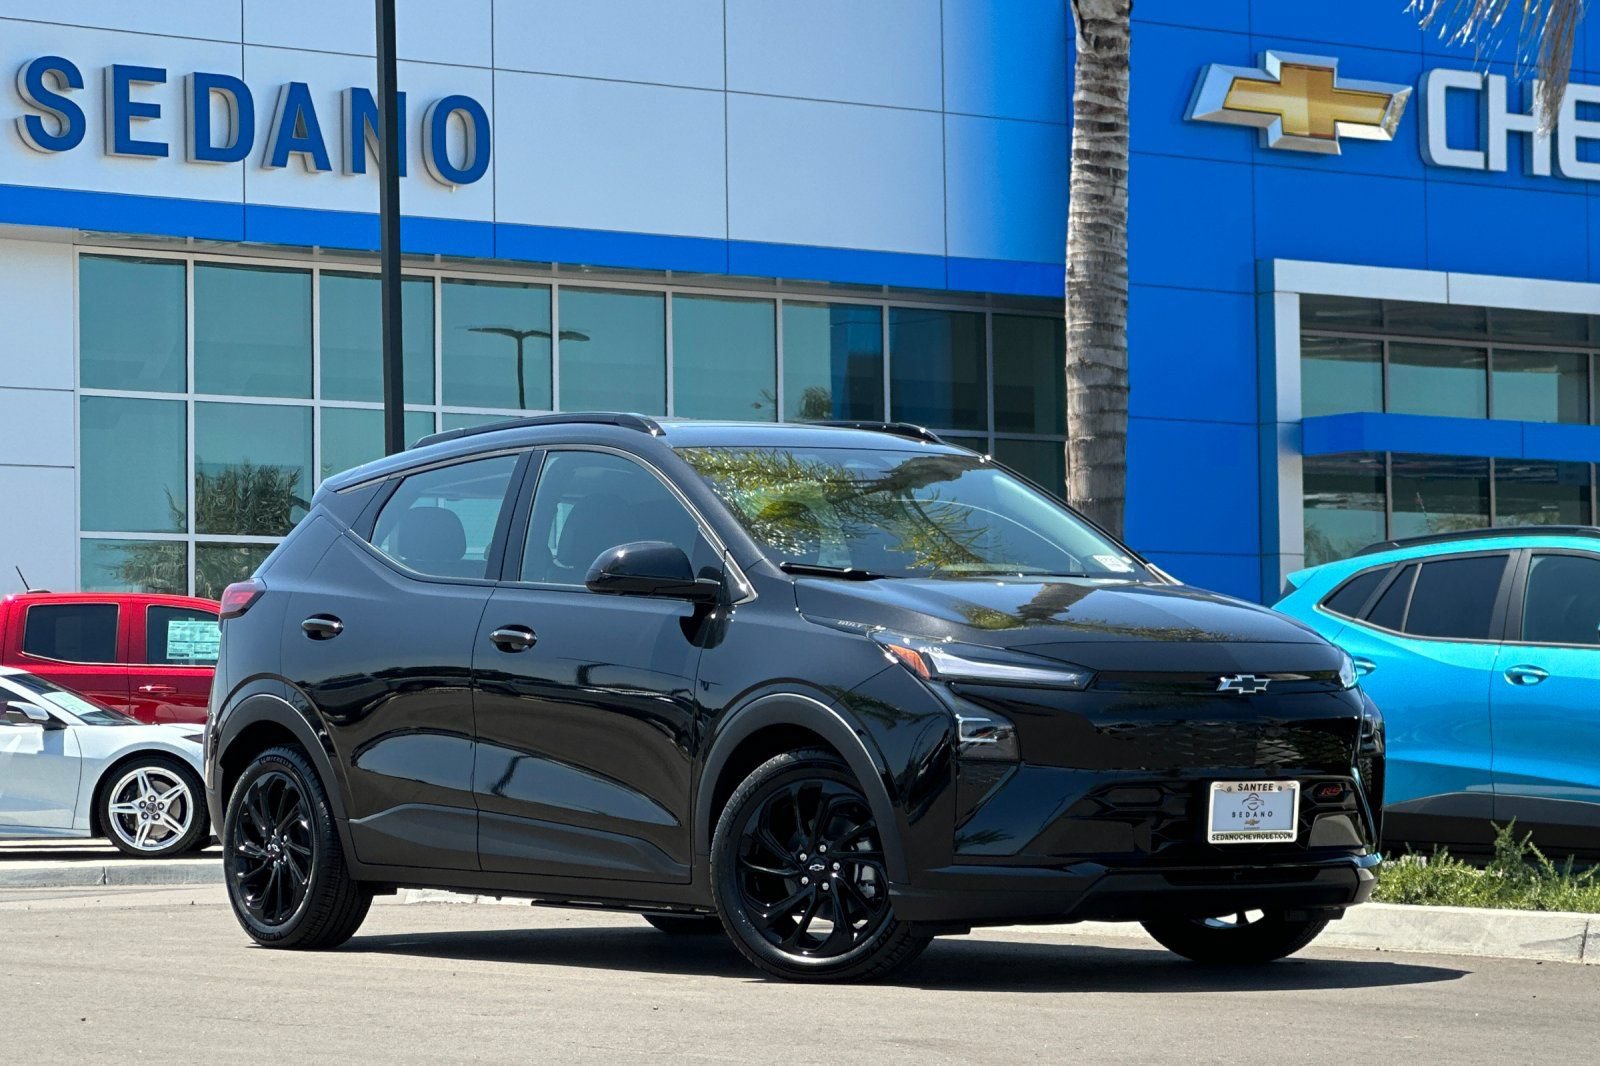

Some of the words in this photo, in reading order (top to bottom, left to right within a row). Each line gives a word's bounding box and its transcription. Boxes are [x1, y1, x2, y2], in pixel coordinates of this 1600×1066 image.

[17, 56, 491, 185] SEDANO
[1419, 67, 1600, 181] CHE
[1237, 783, 1274, 792] SANTEE
